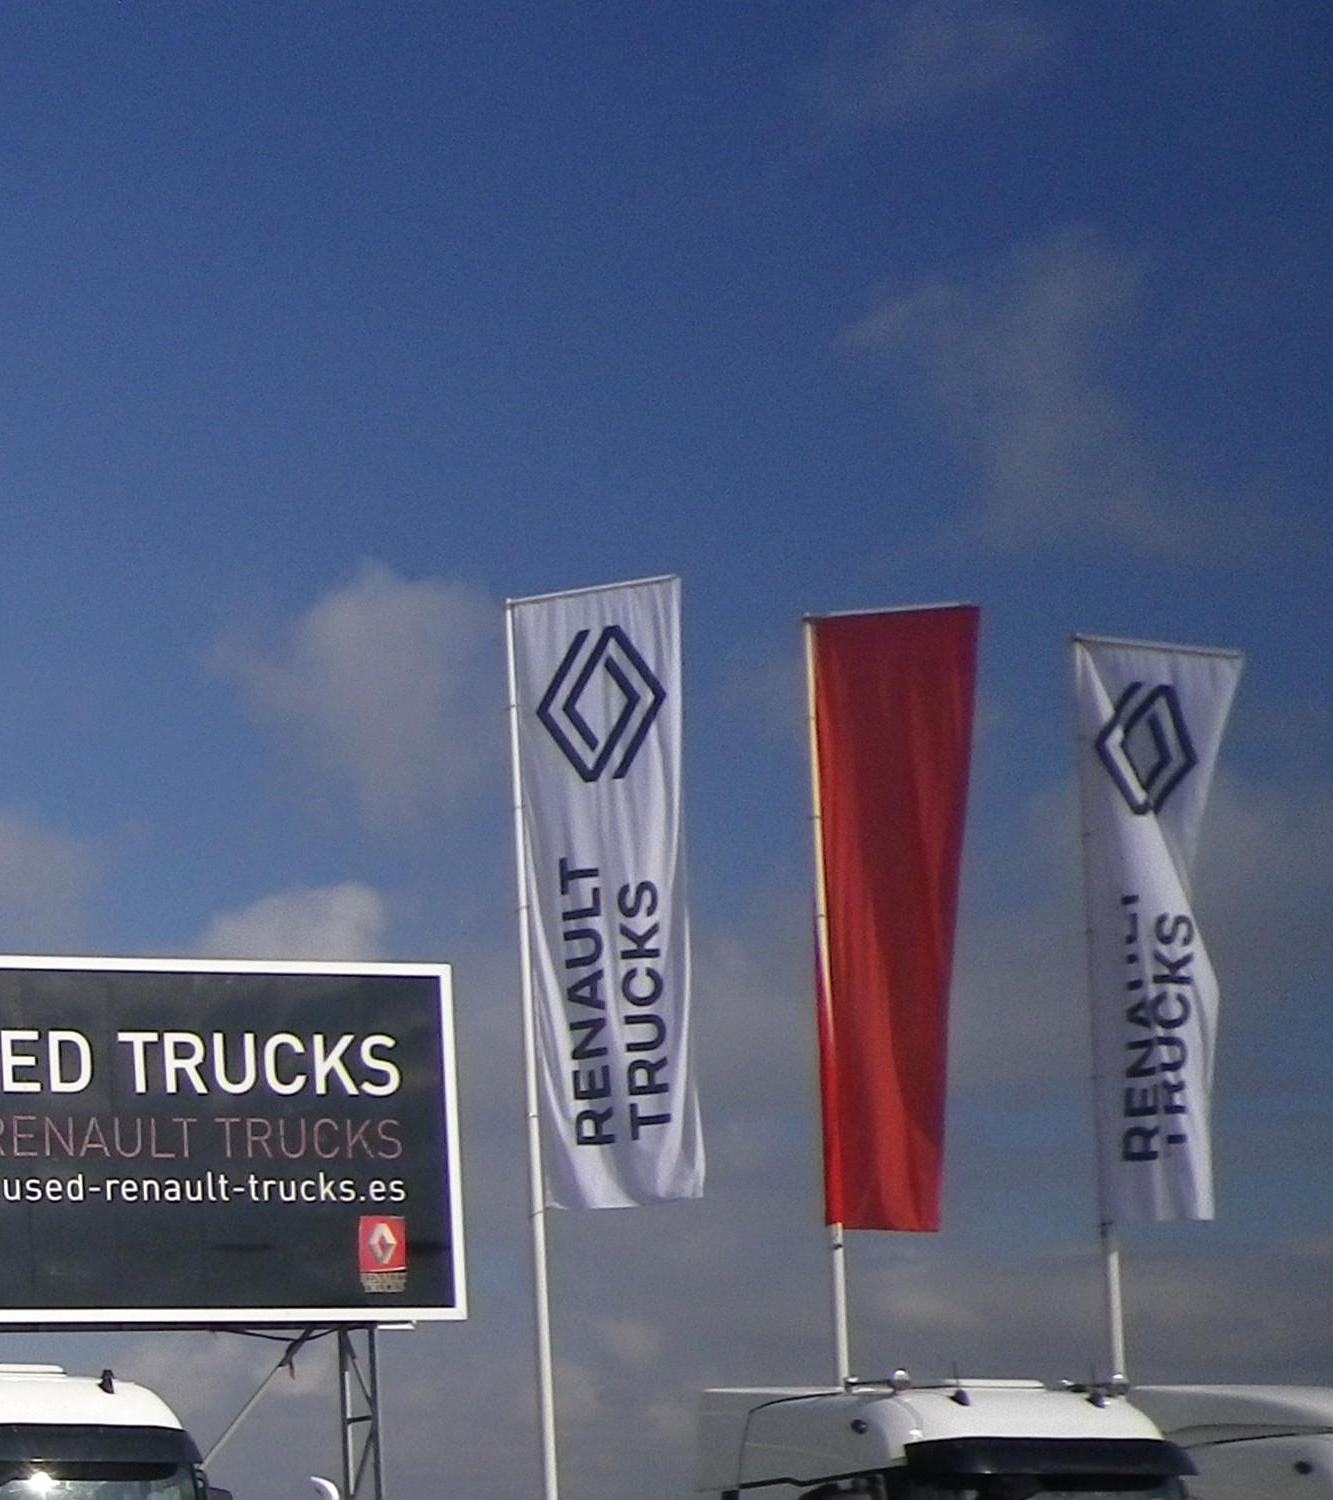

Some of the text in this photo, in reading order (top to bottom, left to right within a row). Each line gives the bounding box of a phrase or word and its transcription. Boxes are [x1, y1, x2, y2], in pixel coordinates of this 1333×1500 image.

[117, 1031, 402, 1096] TRUCKS
[559, 857, 615, 1145] RENAULT
[617, 880, 671, 1140] TRUCKS
[214, 1117, 403, 1160] TRUCKS
